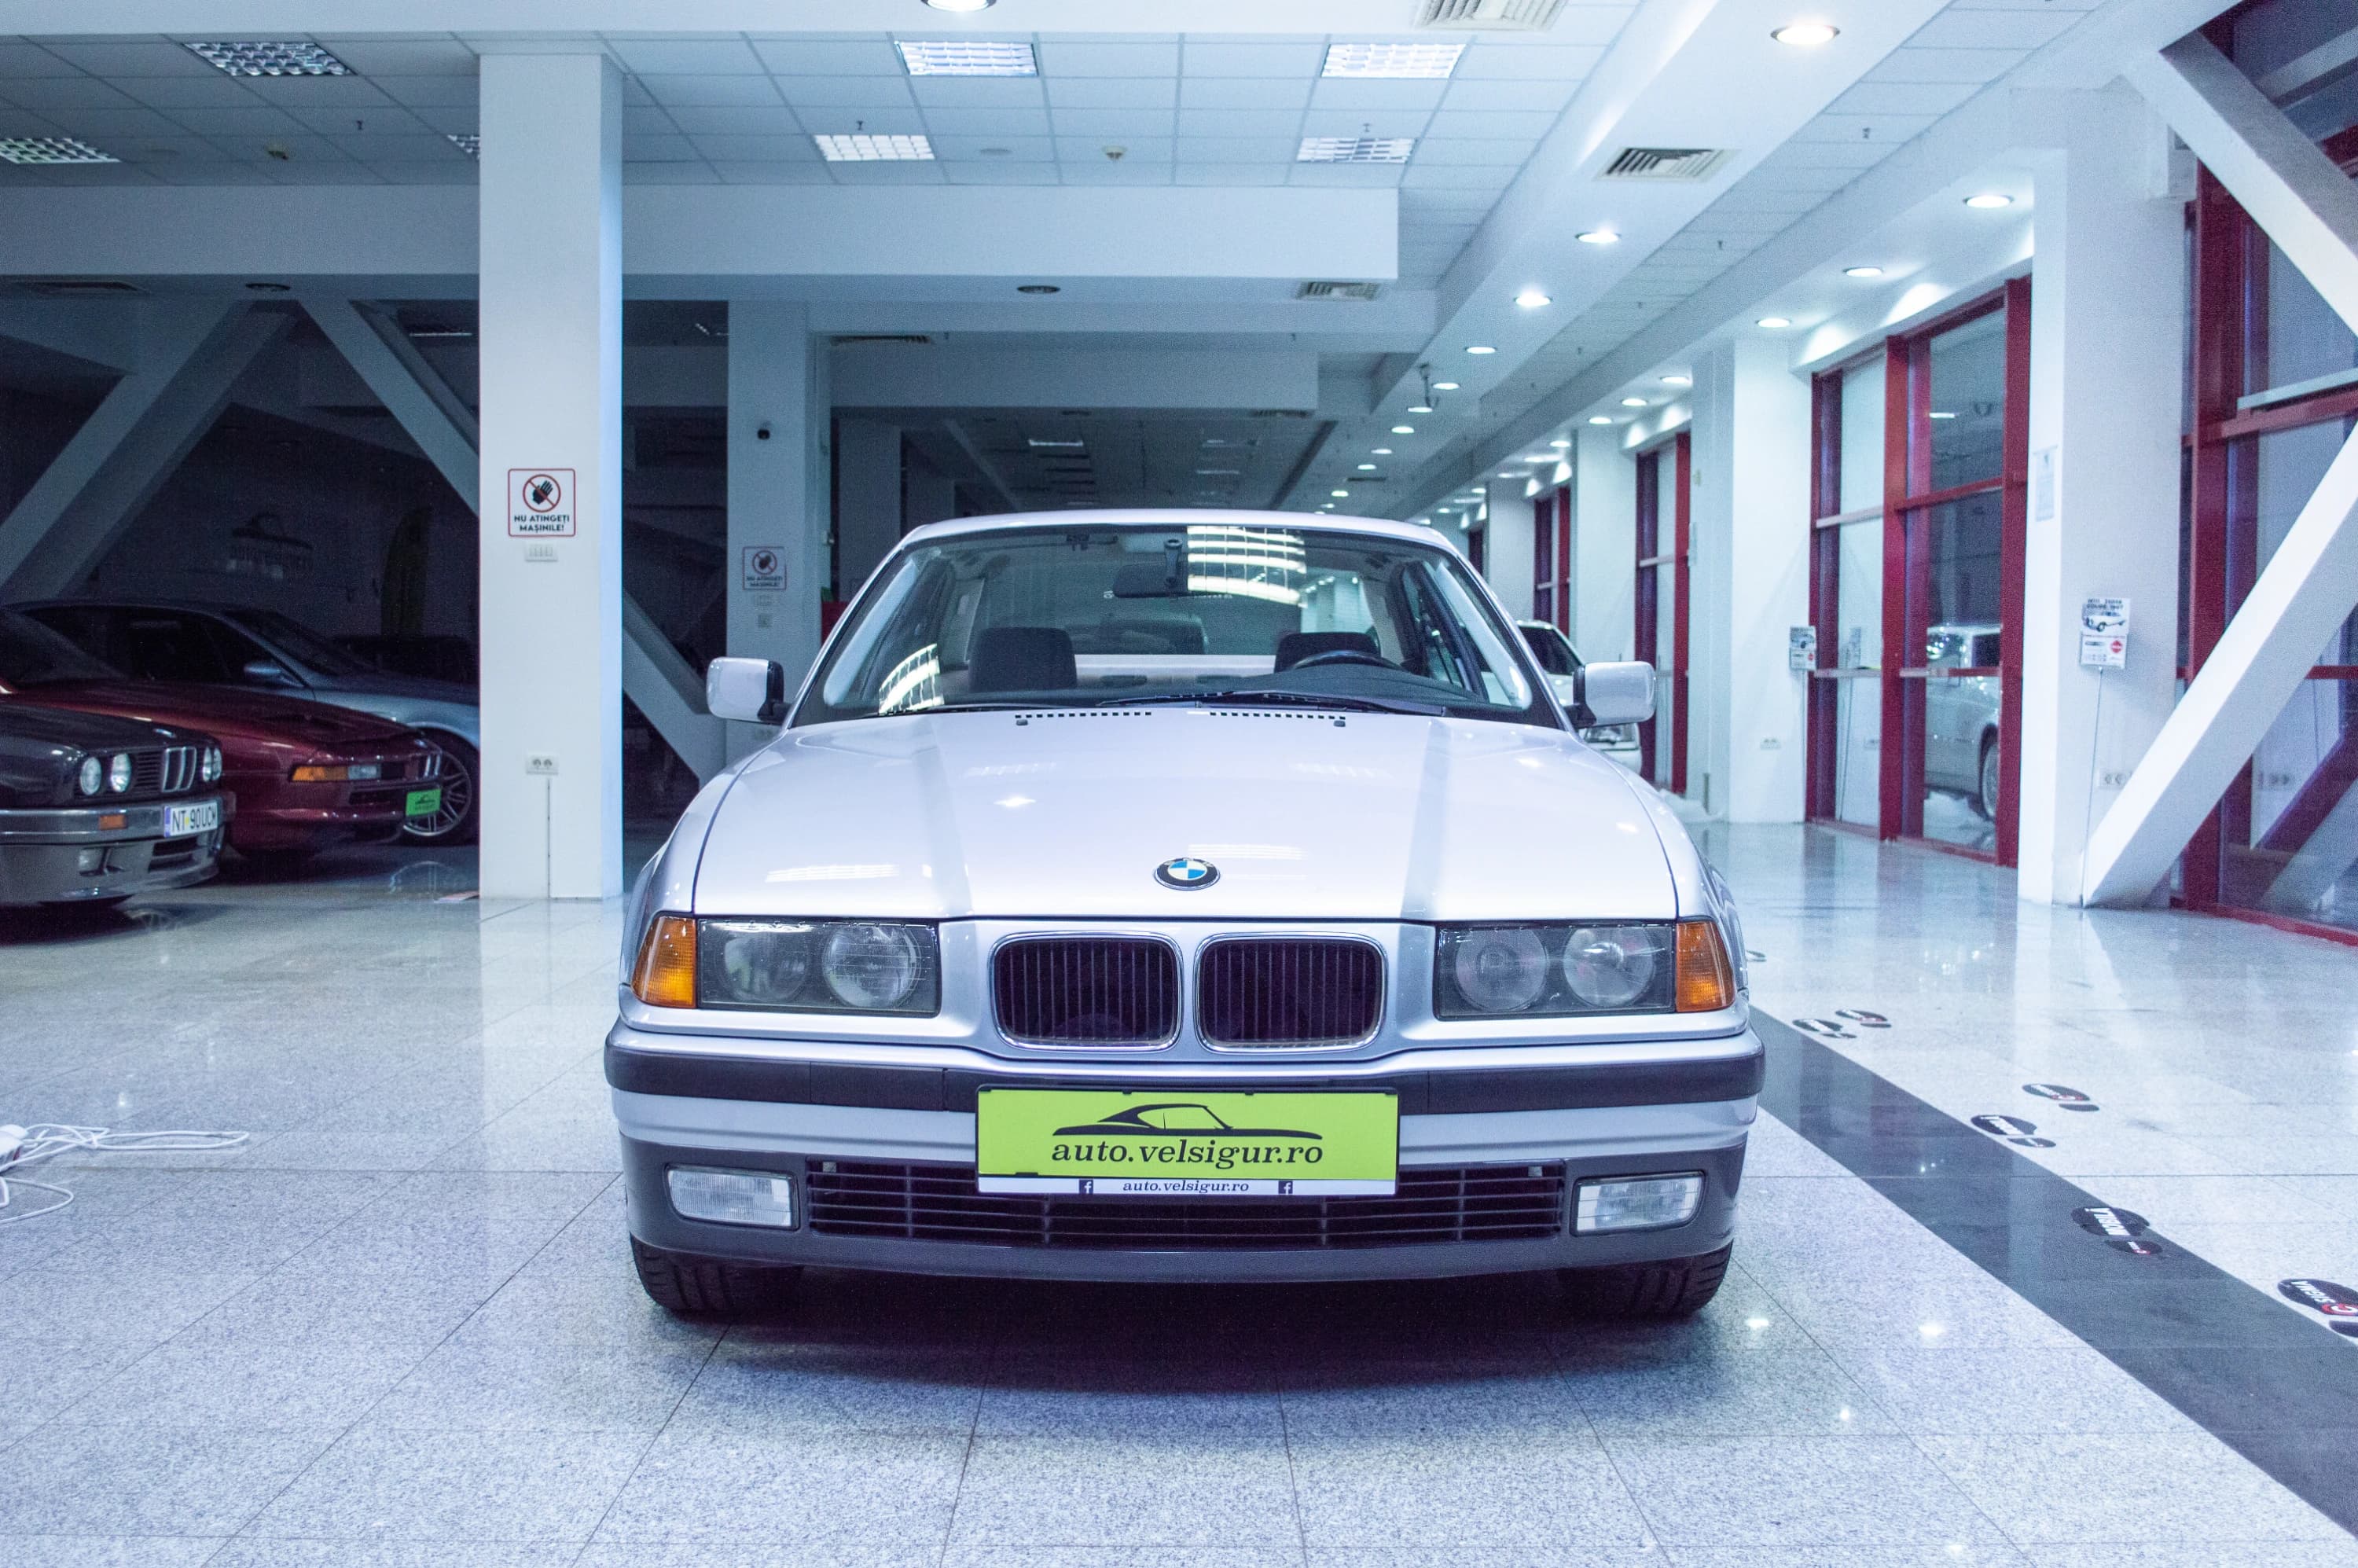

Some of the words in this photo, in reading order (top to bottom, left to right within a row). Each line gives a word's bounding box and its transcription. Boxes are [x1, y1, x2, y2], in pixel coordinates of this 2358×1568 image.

[173, 810, 186, 832] NT
[1051, 1139, 1324, 1170] auto.velsigur.ro
[1122, 1180, 1250, 1194] auto.velsigur.ro
[2290, 1280, 2337, 1304] SIGMA
